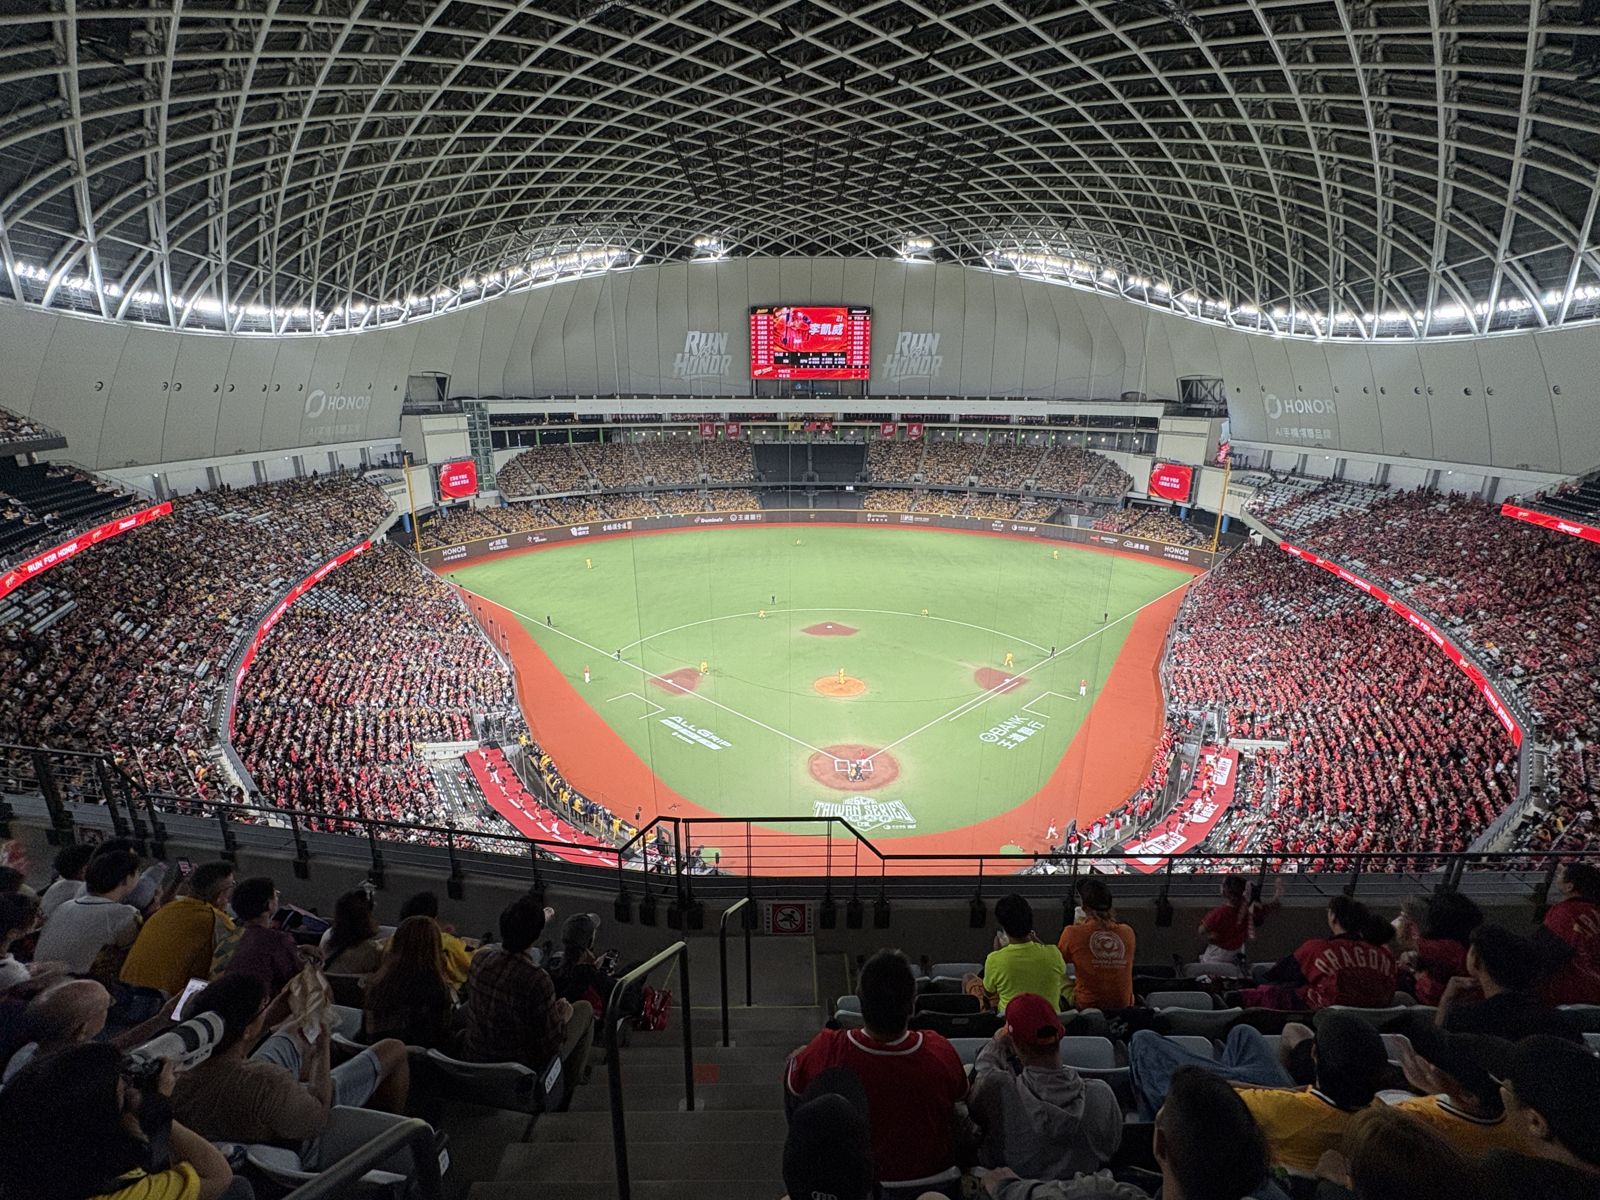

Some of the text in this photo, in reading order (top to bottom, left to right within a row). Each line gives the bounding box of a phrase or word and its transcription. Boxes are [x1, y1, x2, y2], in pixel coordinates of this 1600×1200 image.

[684, 330, 729, 355] RUN
[896, 331, 940, 356] RUN
[672, 353, 732, 377] HONOR
[881, 354, 944, 378] HONOR
[327, 396, 370, 411] HONOR
[1284, 399, 1336, 414] HONOR
[442, 545, 467, 556] HONOR
[1164, 545, 1190, 556] HONOR
[27, 561, 43, 574] RUN
[813, 801, 862, 818] TAIWAN
[864, 799, 914, 822] SERIES
